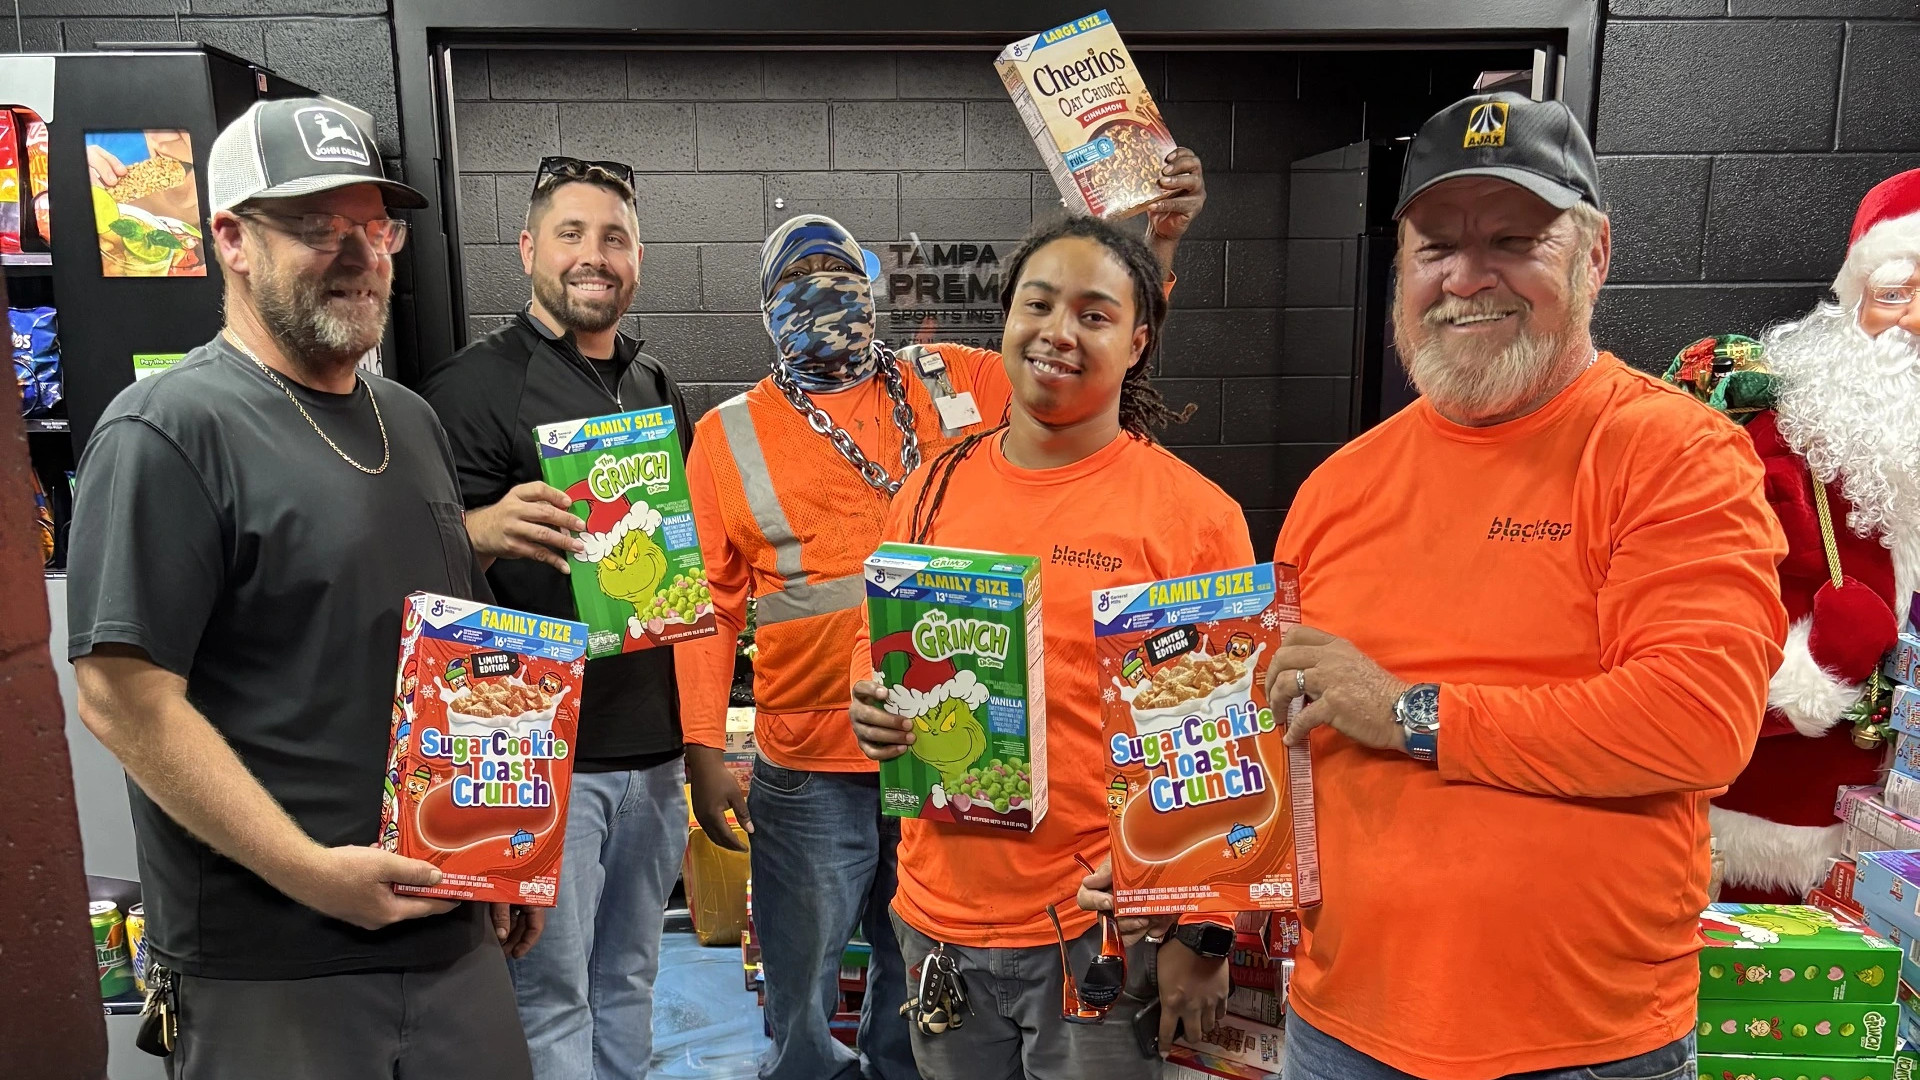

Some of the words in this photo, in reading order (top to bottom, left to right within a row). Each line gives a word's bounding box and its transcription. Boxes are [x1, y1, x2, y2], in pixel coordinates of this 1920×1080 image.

[1042, 21, 1077, 44] LARGE
[1078, 15, 1101, 33] SIZE
[1033, 48, 1126, 98] Cheerios
[1058, 96, 1083, 117] OAT
[1081, 76, 1131, 105] CRUNCH
[1083, 102, 1123, 123] CINNAMON
[1468, 135, 1501, 146] AJAX
[316, 146, 340, 156] JOHN
[341, 147, 366, 161] DEERE
[1070, 154, 1088, 167] FULL
[889, 244, 1000, 266] TAMPA
[890, 273, 999, 304] PREM
[891, 308, 962, 322] SPORTS
[967, 308, 1004, 322] INST
[584, 417, 632, 438] FAMILY
[634, 412, 664, 430] SIZE
[597, 457, 614, 468] The
[591, 454, 668, 499] GRINCH
[663, 514, 692, 526] VANILLA
[1488, 516, 1572, 541] blacktop
[1052, 544, 1123, 573] blacktop
[916, 572, 972, 592] FAMILY
[975, 578, 1010, 597] SIZE
[1149, 577, 1212, 607] FAMILY
[1215, 571, 1254, 597] SIZE
[927, 613, 945, 622] The
[1231, 602, 1244, 614] 12
[481, 609, 537, 636] FAMILY
[539, 620, 572, 643] SIZE
[550, 646, 560, 657] 12
[915, 621, 1008, 658] GRINCH
[1152, 629, 1186, 650] LIMITED
[1155, 637, 1189, 660] EDITION
[478, 655, 508, 665] LIMITED
[480, 663, 510, 674] EDITION
[989, 696, 1023, 708] VANILLA
[470, 756, 534, 783] Toast
[1164, 741, 1239, 779] Toast
[454, 776, 549, 806] Crunch
[1152, 758, 1264, 812] Crunch
[1865, 1012, 1881, 1050] GRINCH
